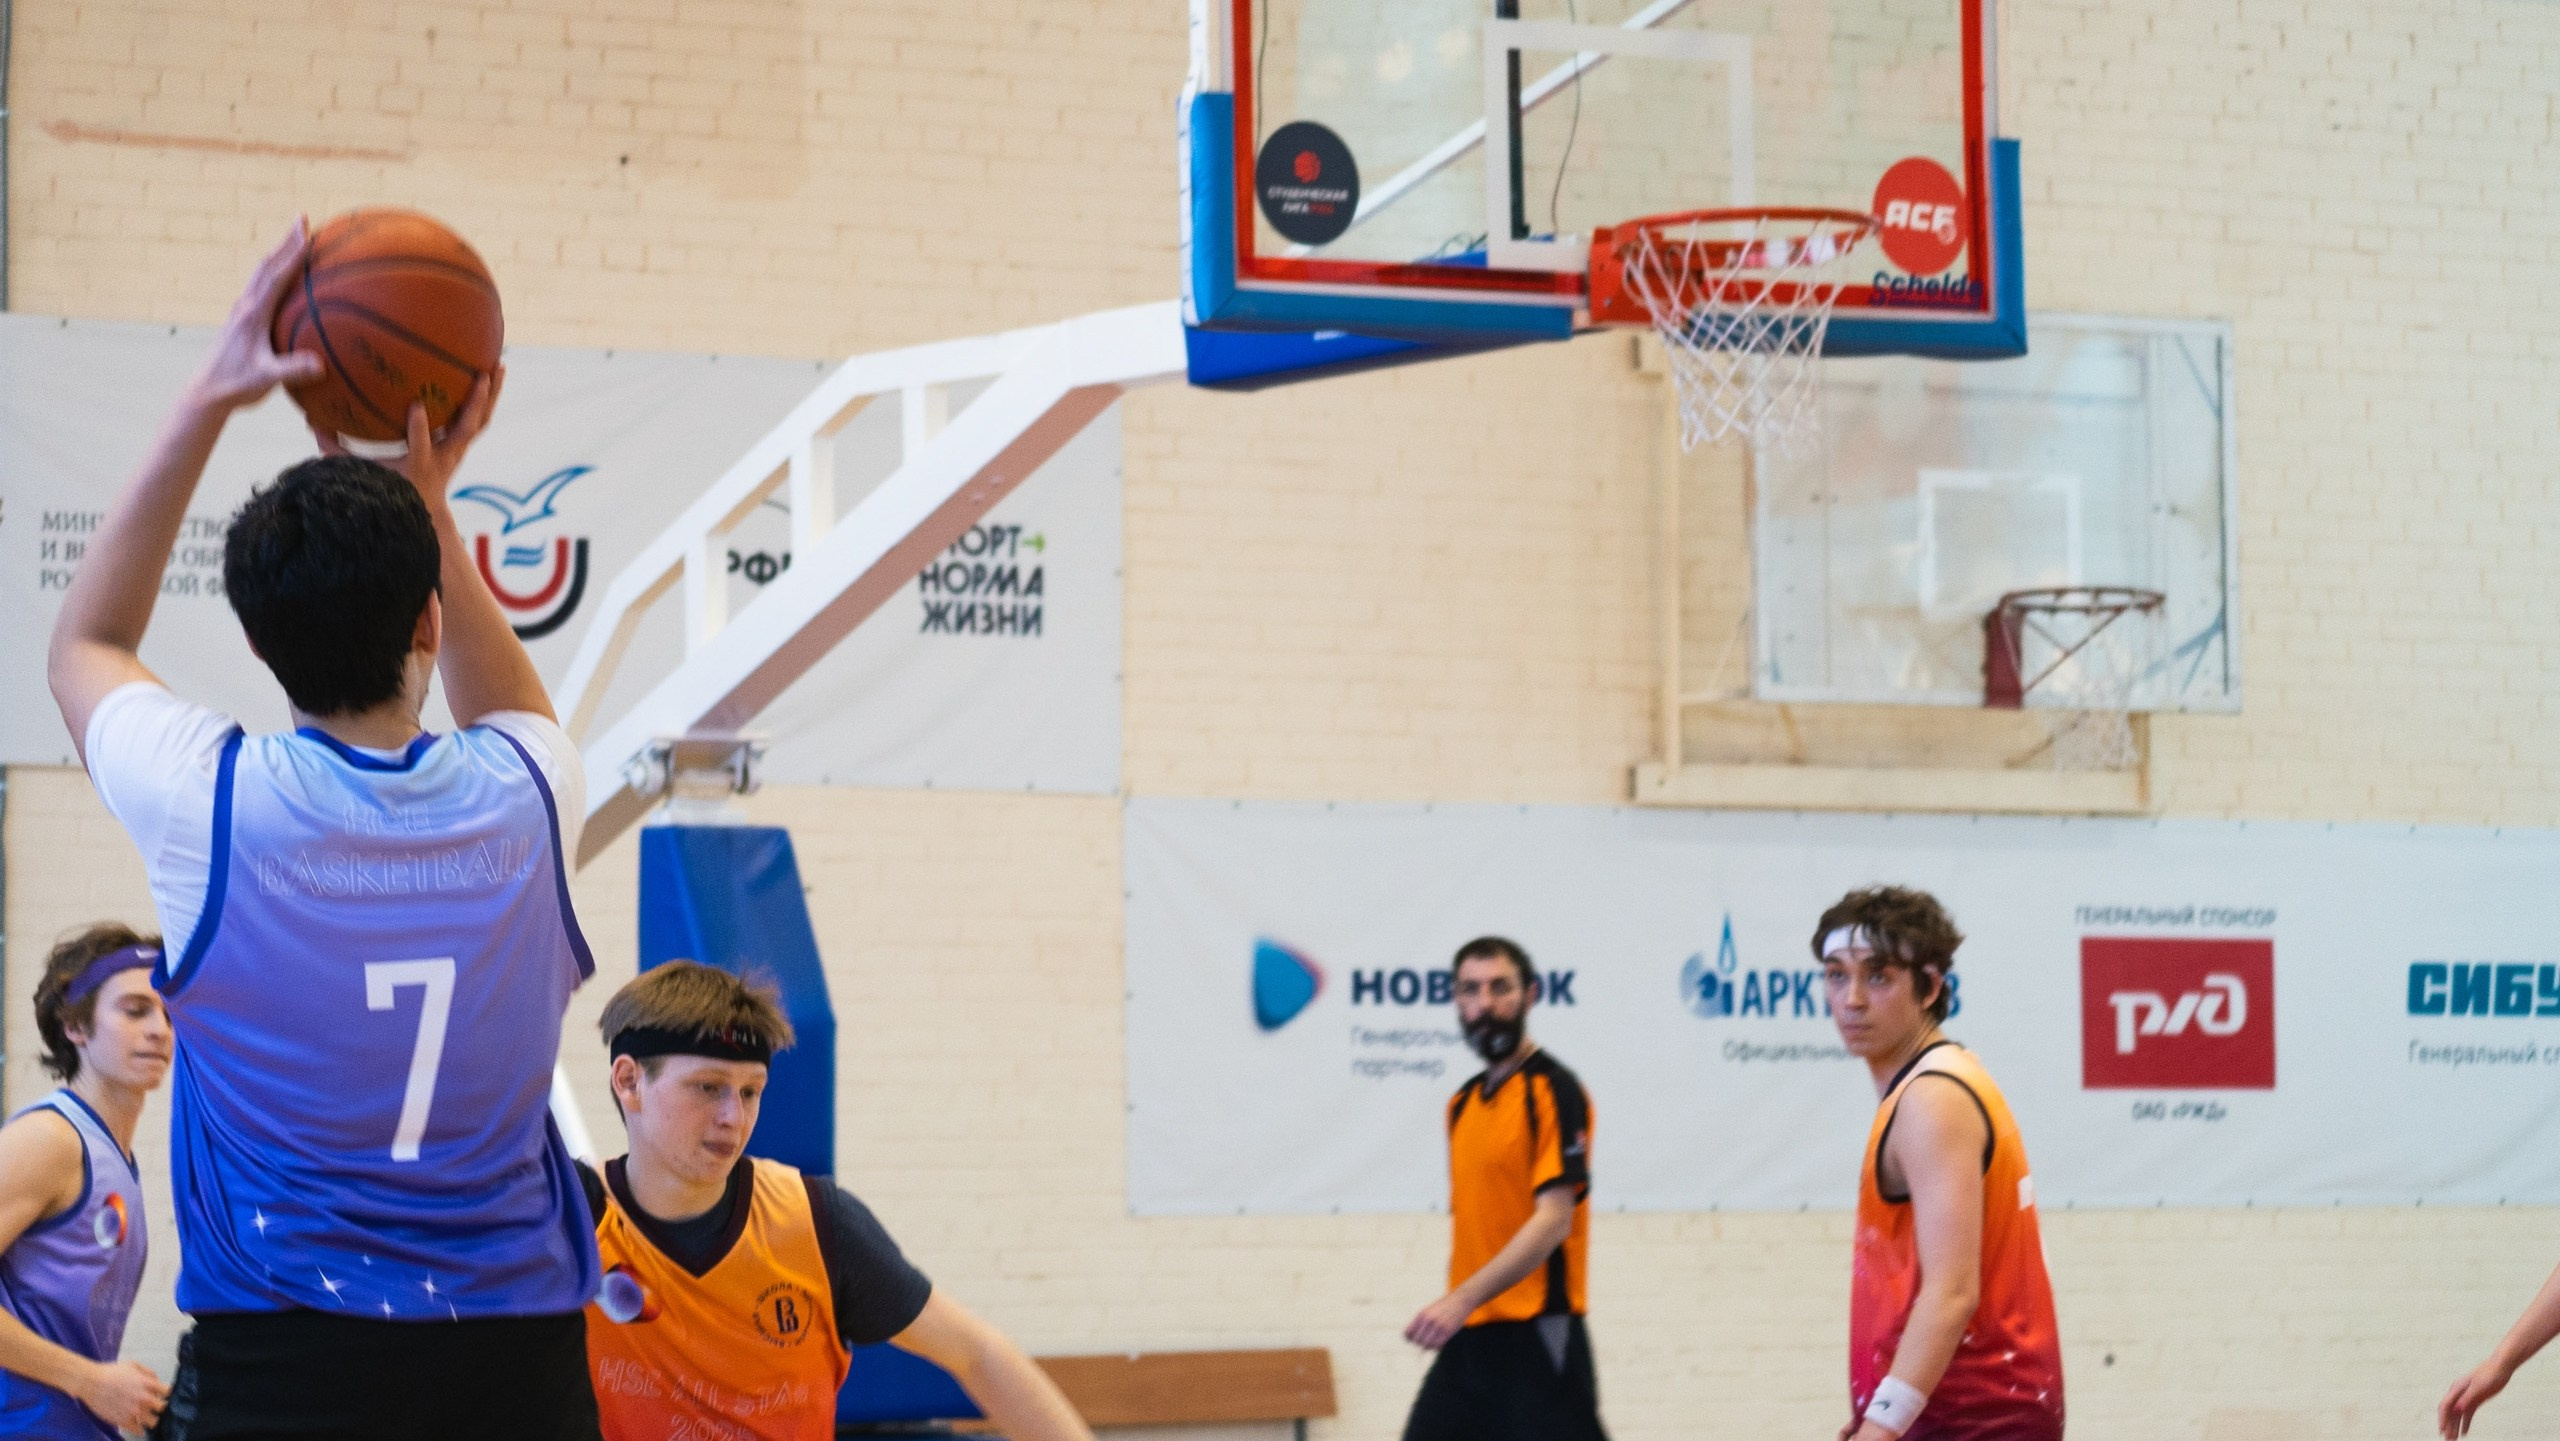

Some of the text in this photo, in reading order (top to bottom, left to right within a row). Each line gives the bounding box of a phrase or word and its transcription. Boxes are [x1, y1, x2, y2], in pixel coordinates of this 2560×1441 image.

[918, 563, 1044, 597] НОРМА
[919, 601, 1044, 637] ЖИЗНИ
[258, 835, 534, 897] BASKETBALL
[364, 957, 457, 1162] 7
[2408, 1038, 2537, 1070] Генеральный
